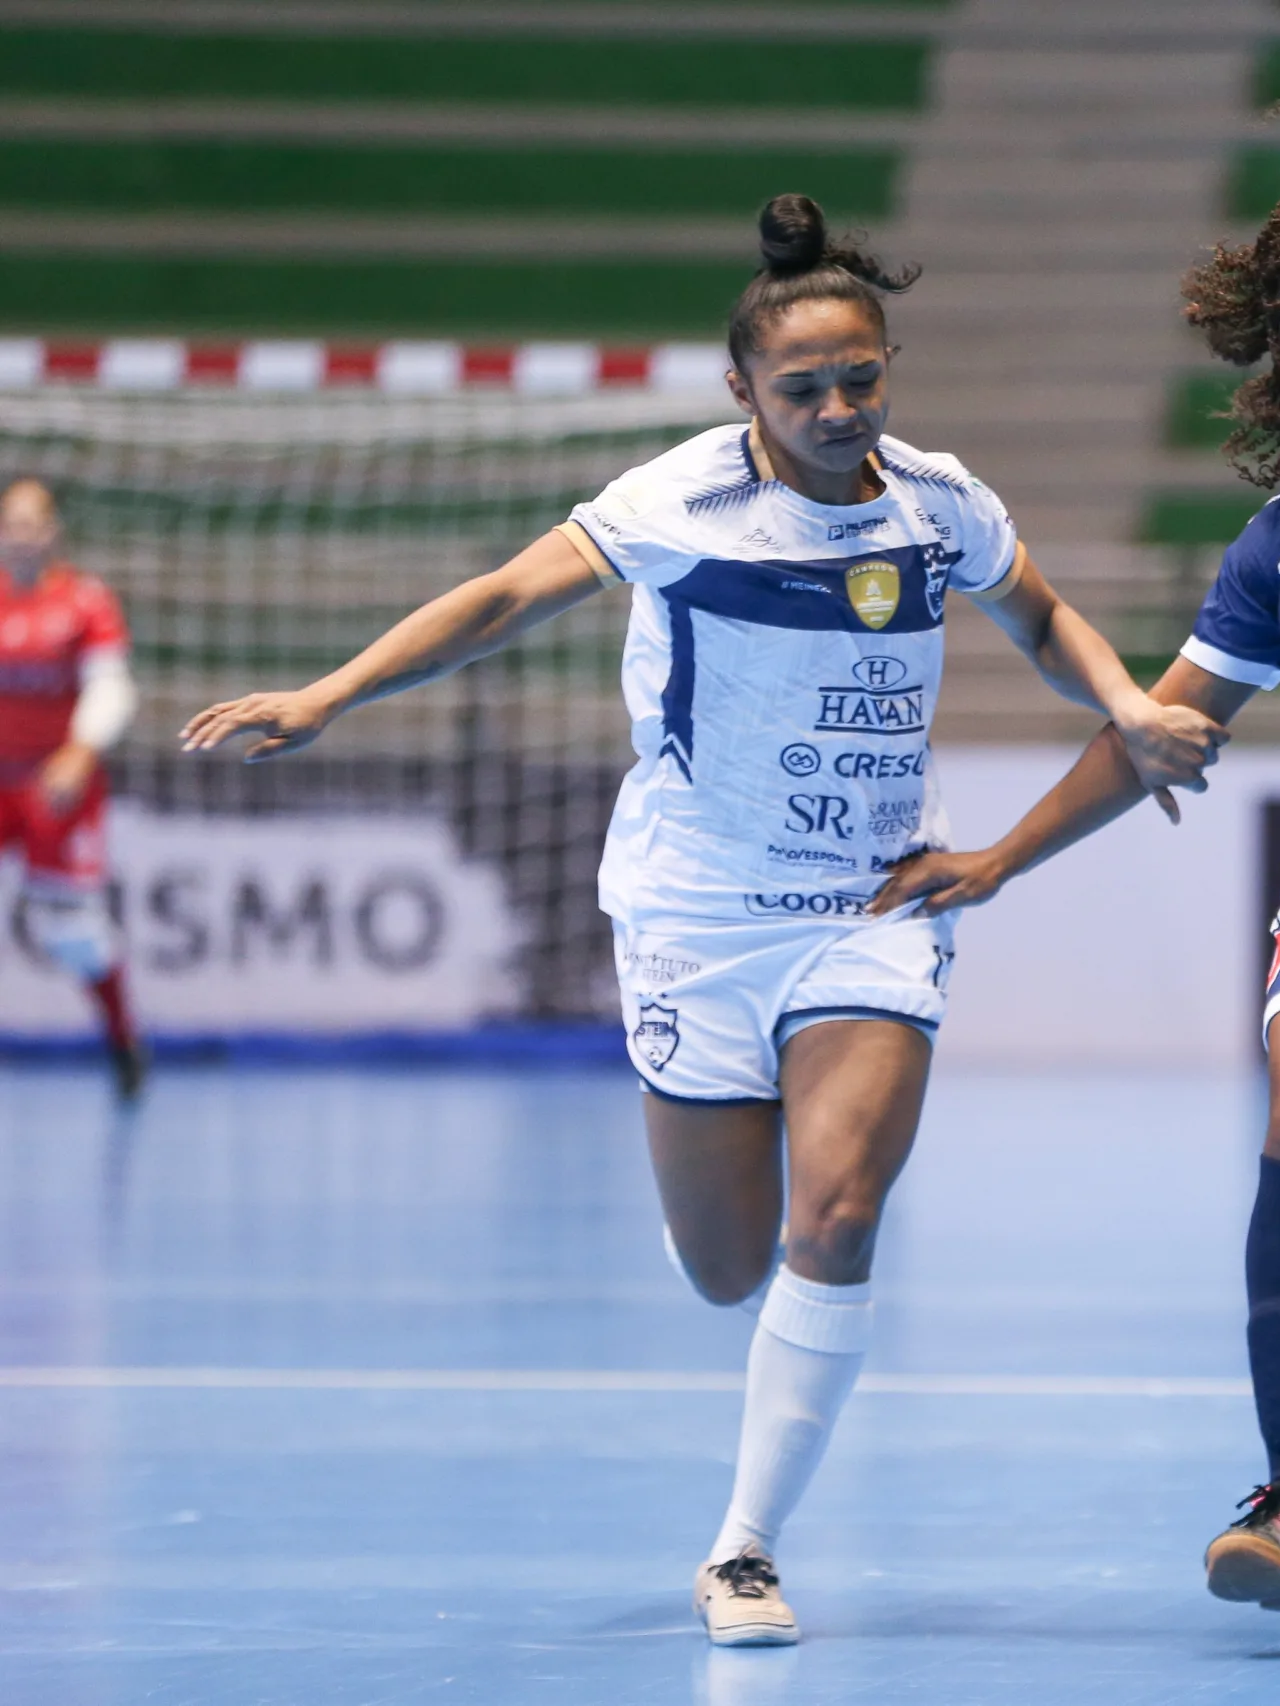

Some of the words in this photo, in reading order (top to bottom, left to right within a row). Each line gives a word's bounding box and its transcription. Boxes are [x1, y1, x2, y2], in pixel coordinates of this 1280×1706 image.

[868, 661, 890, 685] H
[816, 693, 923, 728] HAVAN
[785, 793, 854, 840] SR.
